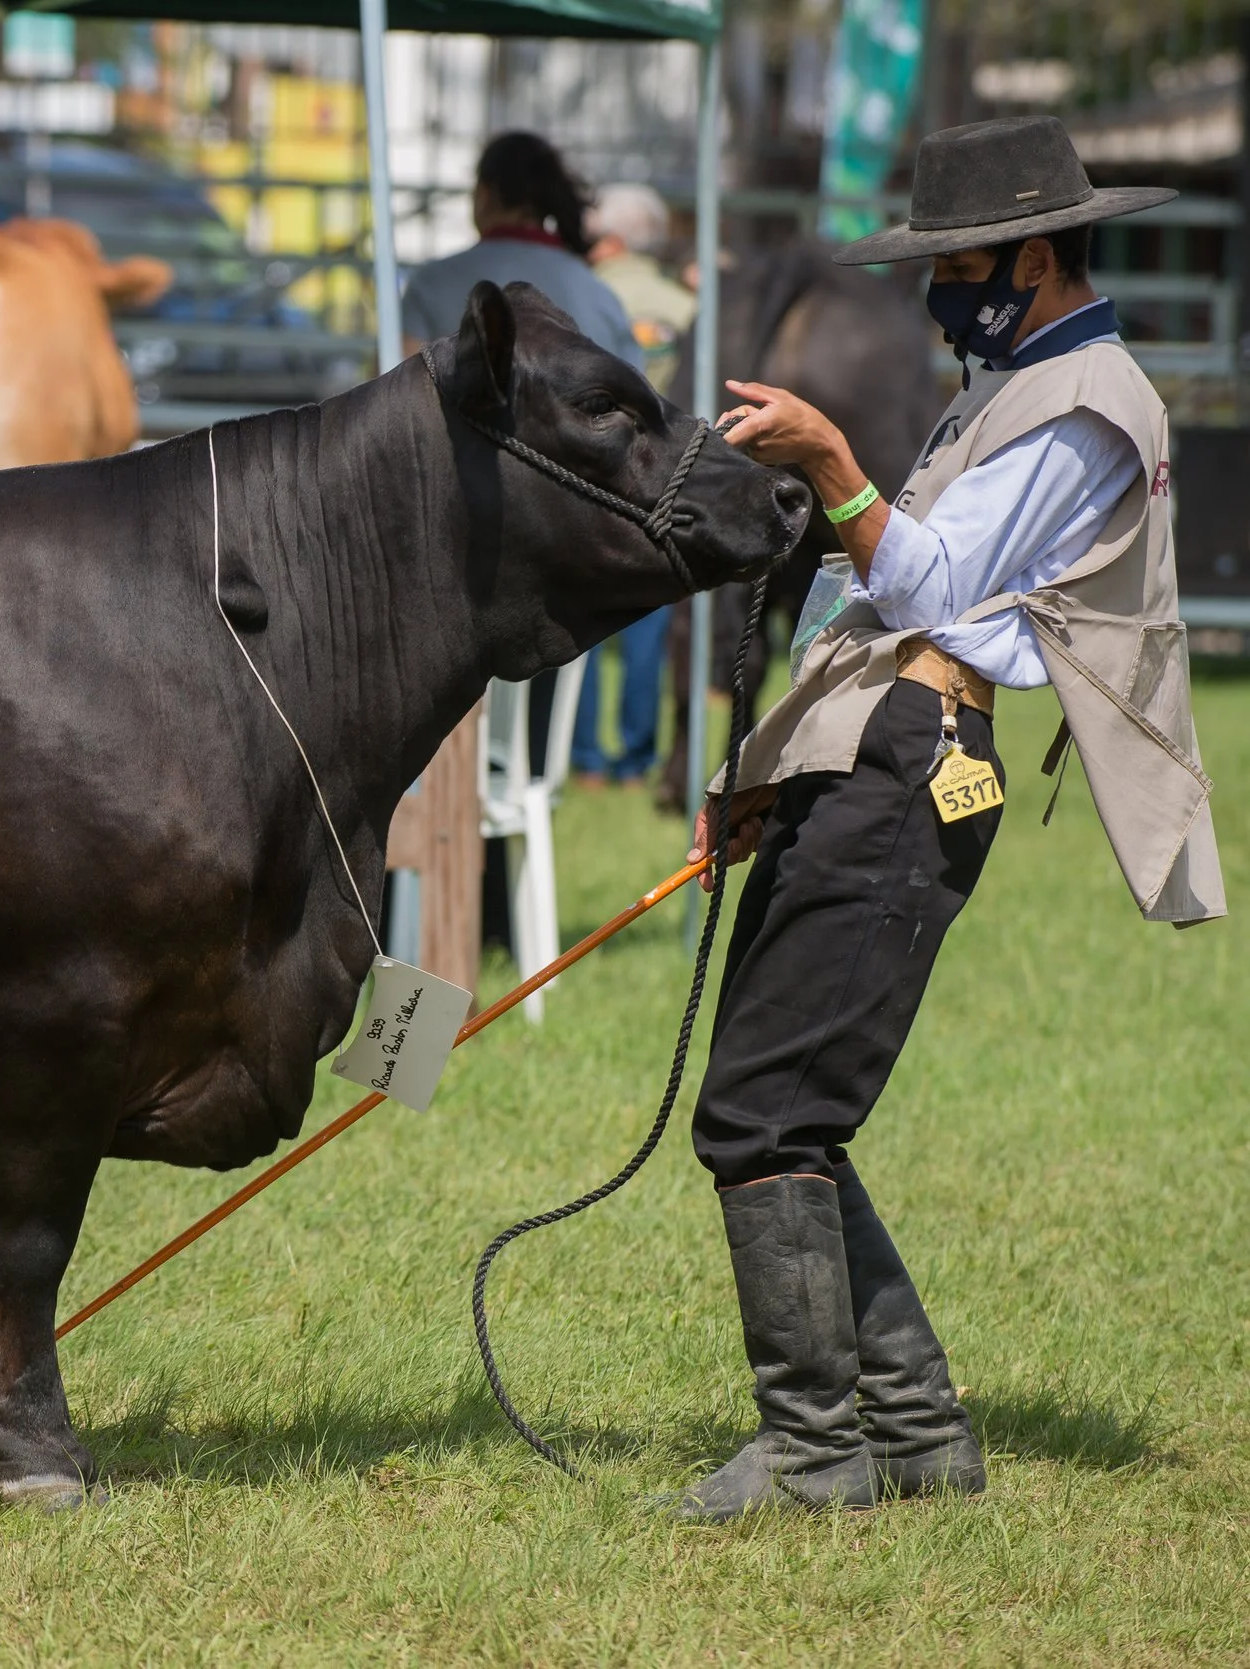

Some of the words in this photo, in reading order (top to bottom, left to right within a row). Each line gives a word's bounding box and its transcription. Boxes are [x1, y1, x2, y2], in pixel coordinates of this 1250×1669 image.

[984, 302, 1015, 336] BRANGUS
[941, 776, 997, 812] 5317
[371, 1060, 396, 1090] Ricardo
